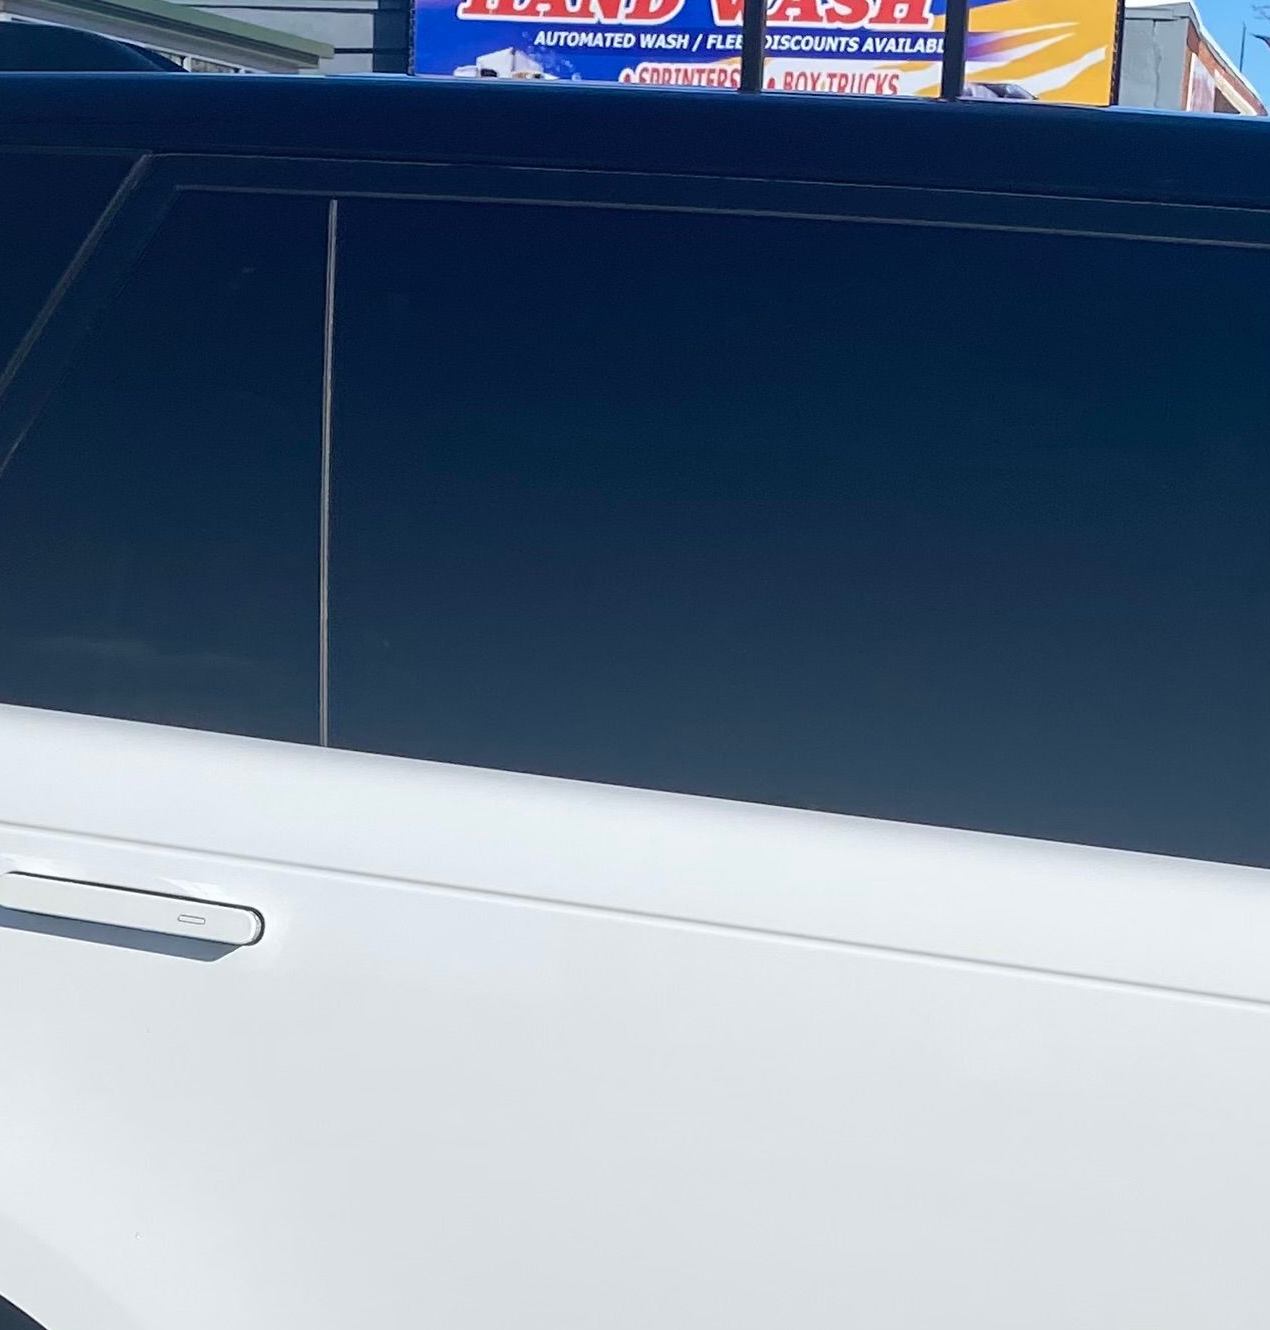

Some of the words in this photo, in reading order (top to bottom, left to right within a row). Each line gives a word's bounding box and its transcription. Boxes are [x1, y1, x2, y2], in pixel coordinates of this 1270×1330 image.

[534, 31, 636, 48] AUTOMATED
[640, 33, 689, 49] WASH
[706, 34, 743, 49] FLEE
[861, 37, 944, 54] AVAILABL
